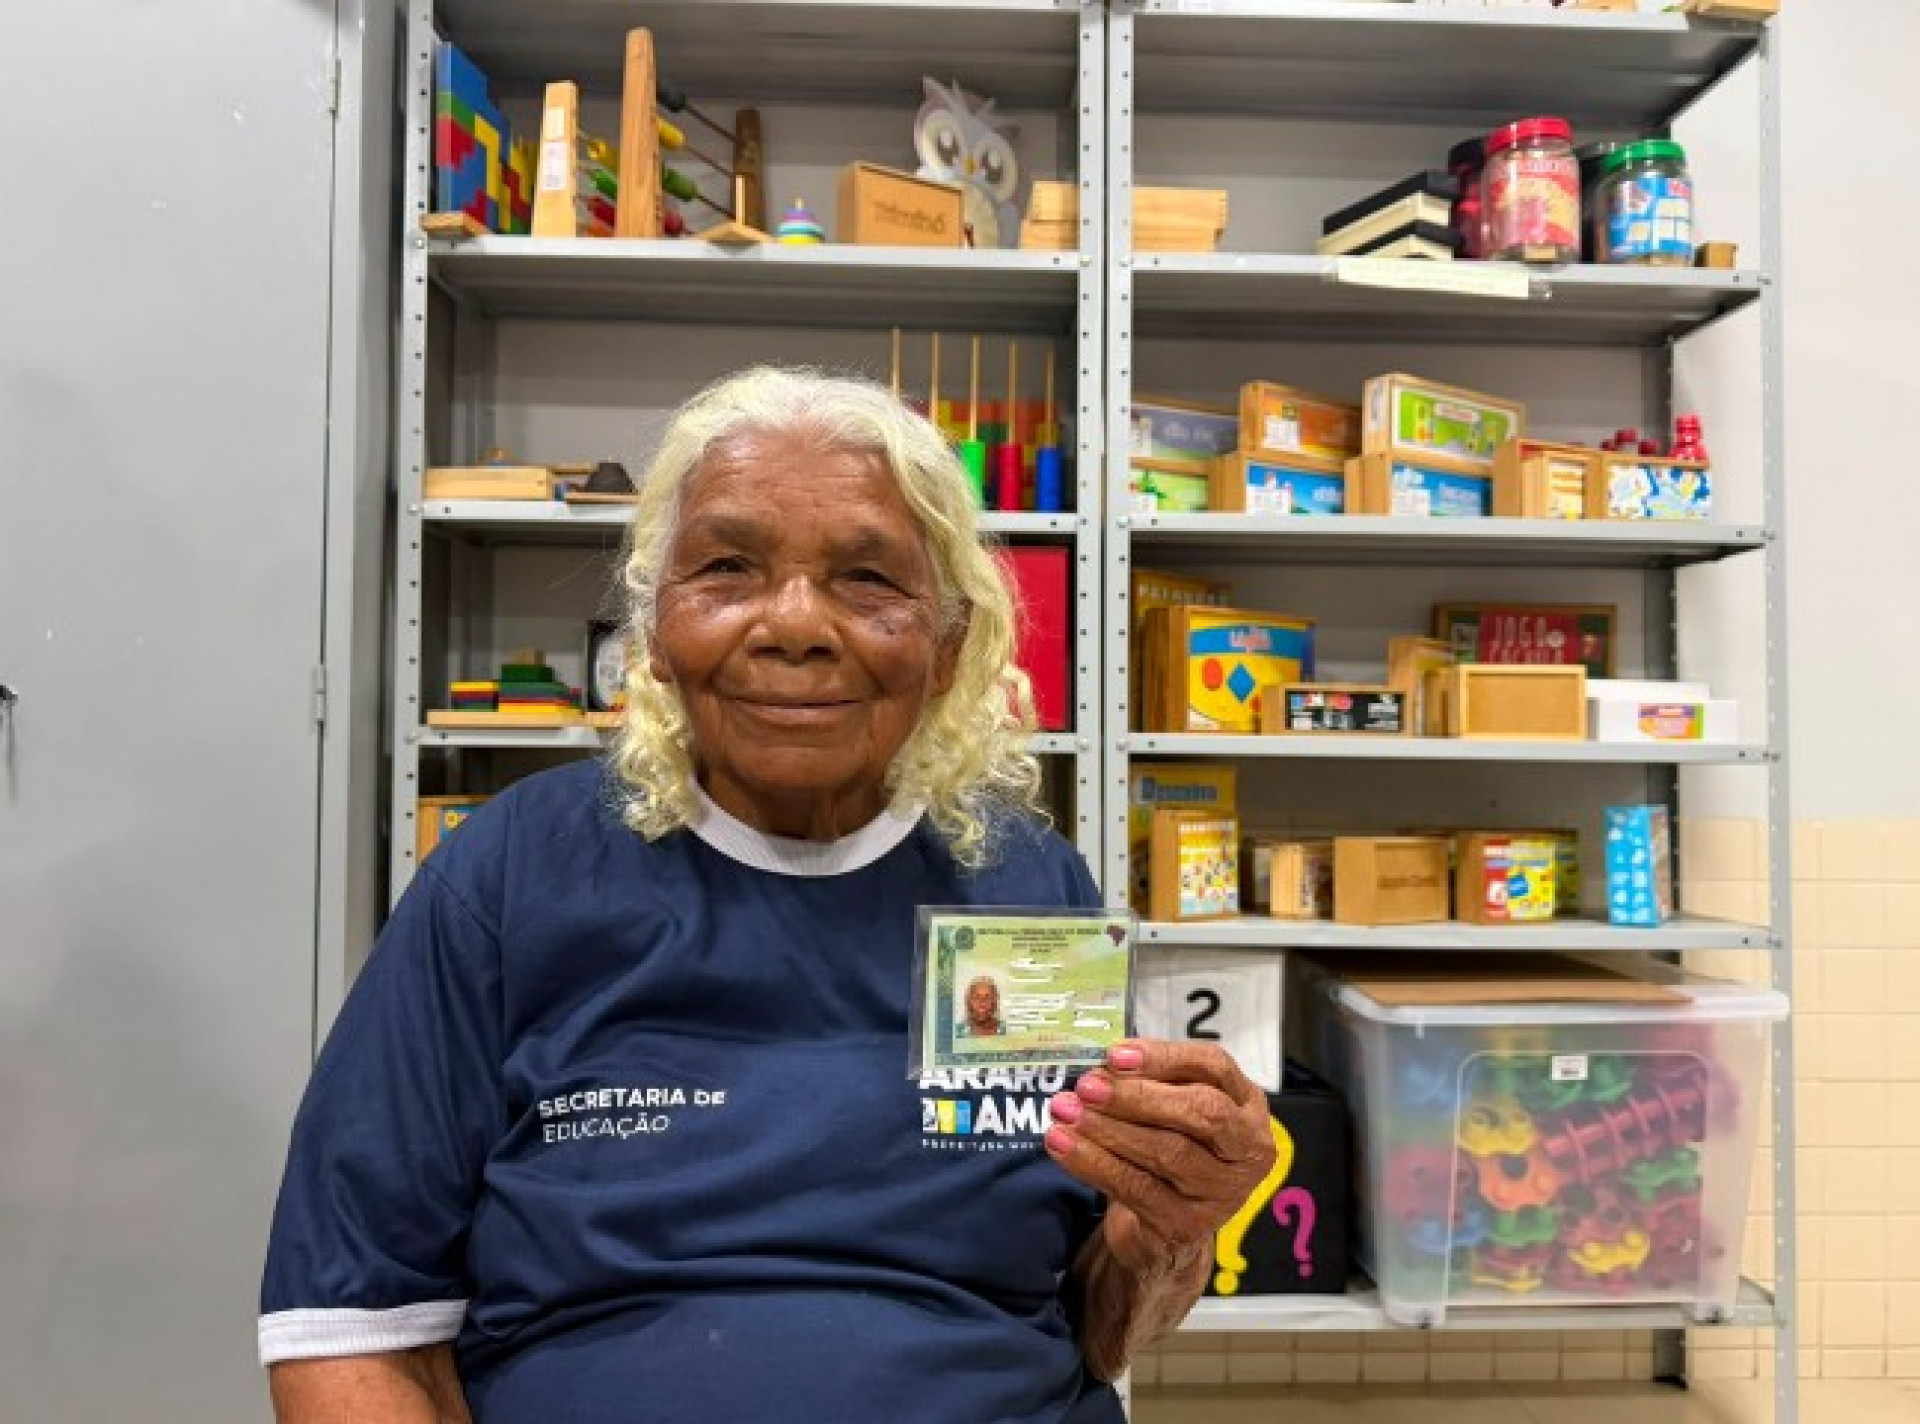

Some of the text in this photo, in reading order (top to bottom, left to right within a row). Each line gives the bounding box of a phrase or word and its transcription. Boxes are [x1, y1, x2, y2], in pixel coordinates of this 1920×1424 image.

[1186, 988, 1221, 1038] 2
[537, 1088, 727, 1118] SECRETARIA DE
[542, 1112, 672, 1143] EDUCAÇÃO
